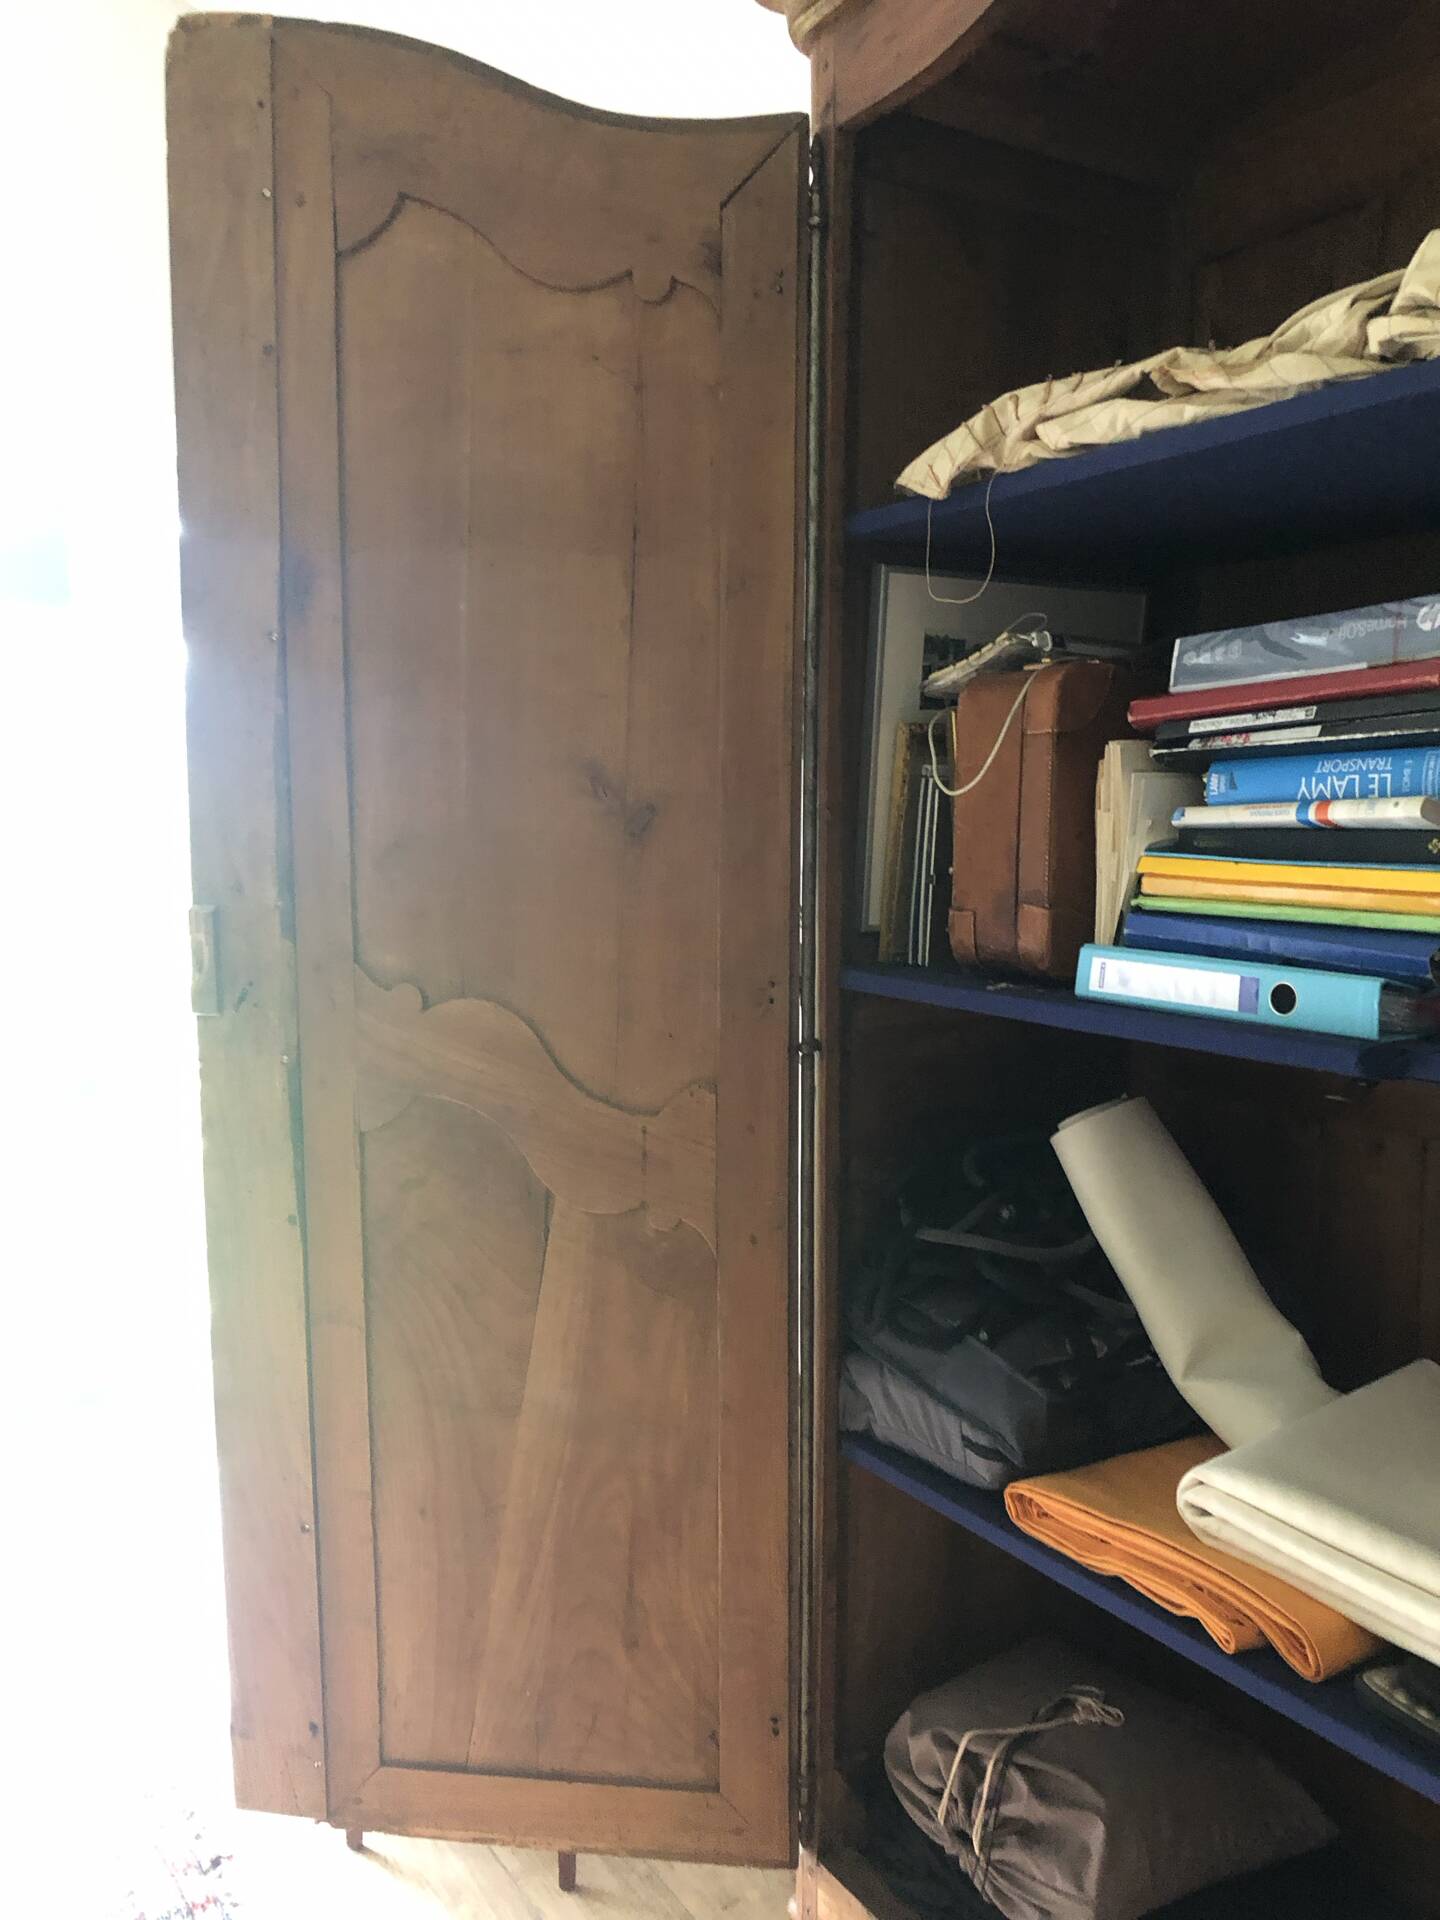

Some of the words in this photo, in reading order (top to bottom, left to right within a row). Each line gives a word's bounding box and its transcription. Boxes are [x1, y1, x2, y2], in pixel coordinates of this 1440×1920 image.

[1315, 756, 1393, 775] TRANSPORT
[1298, 776, 1361, 801] LAMY
[1366, 774, 1393, 800] LE
